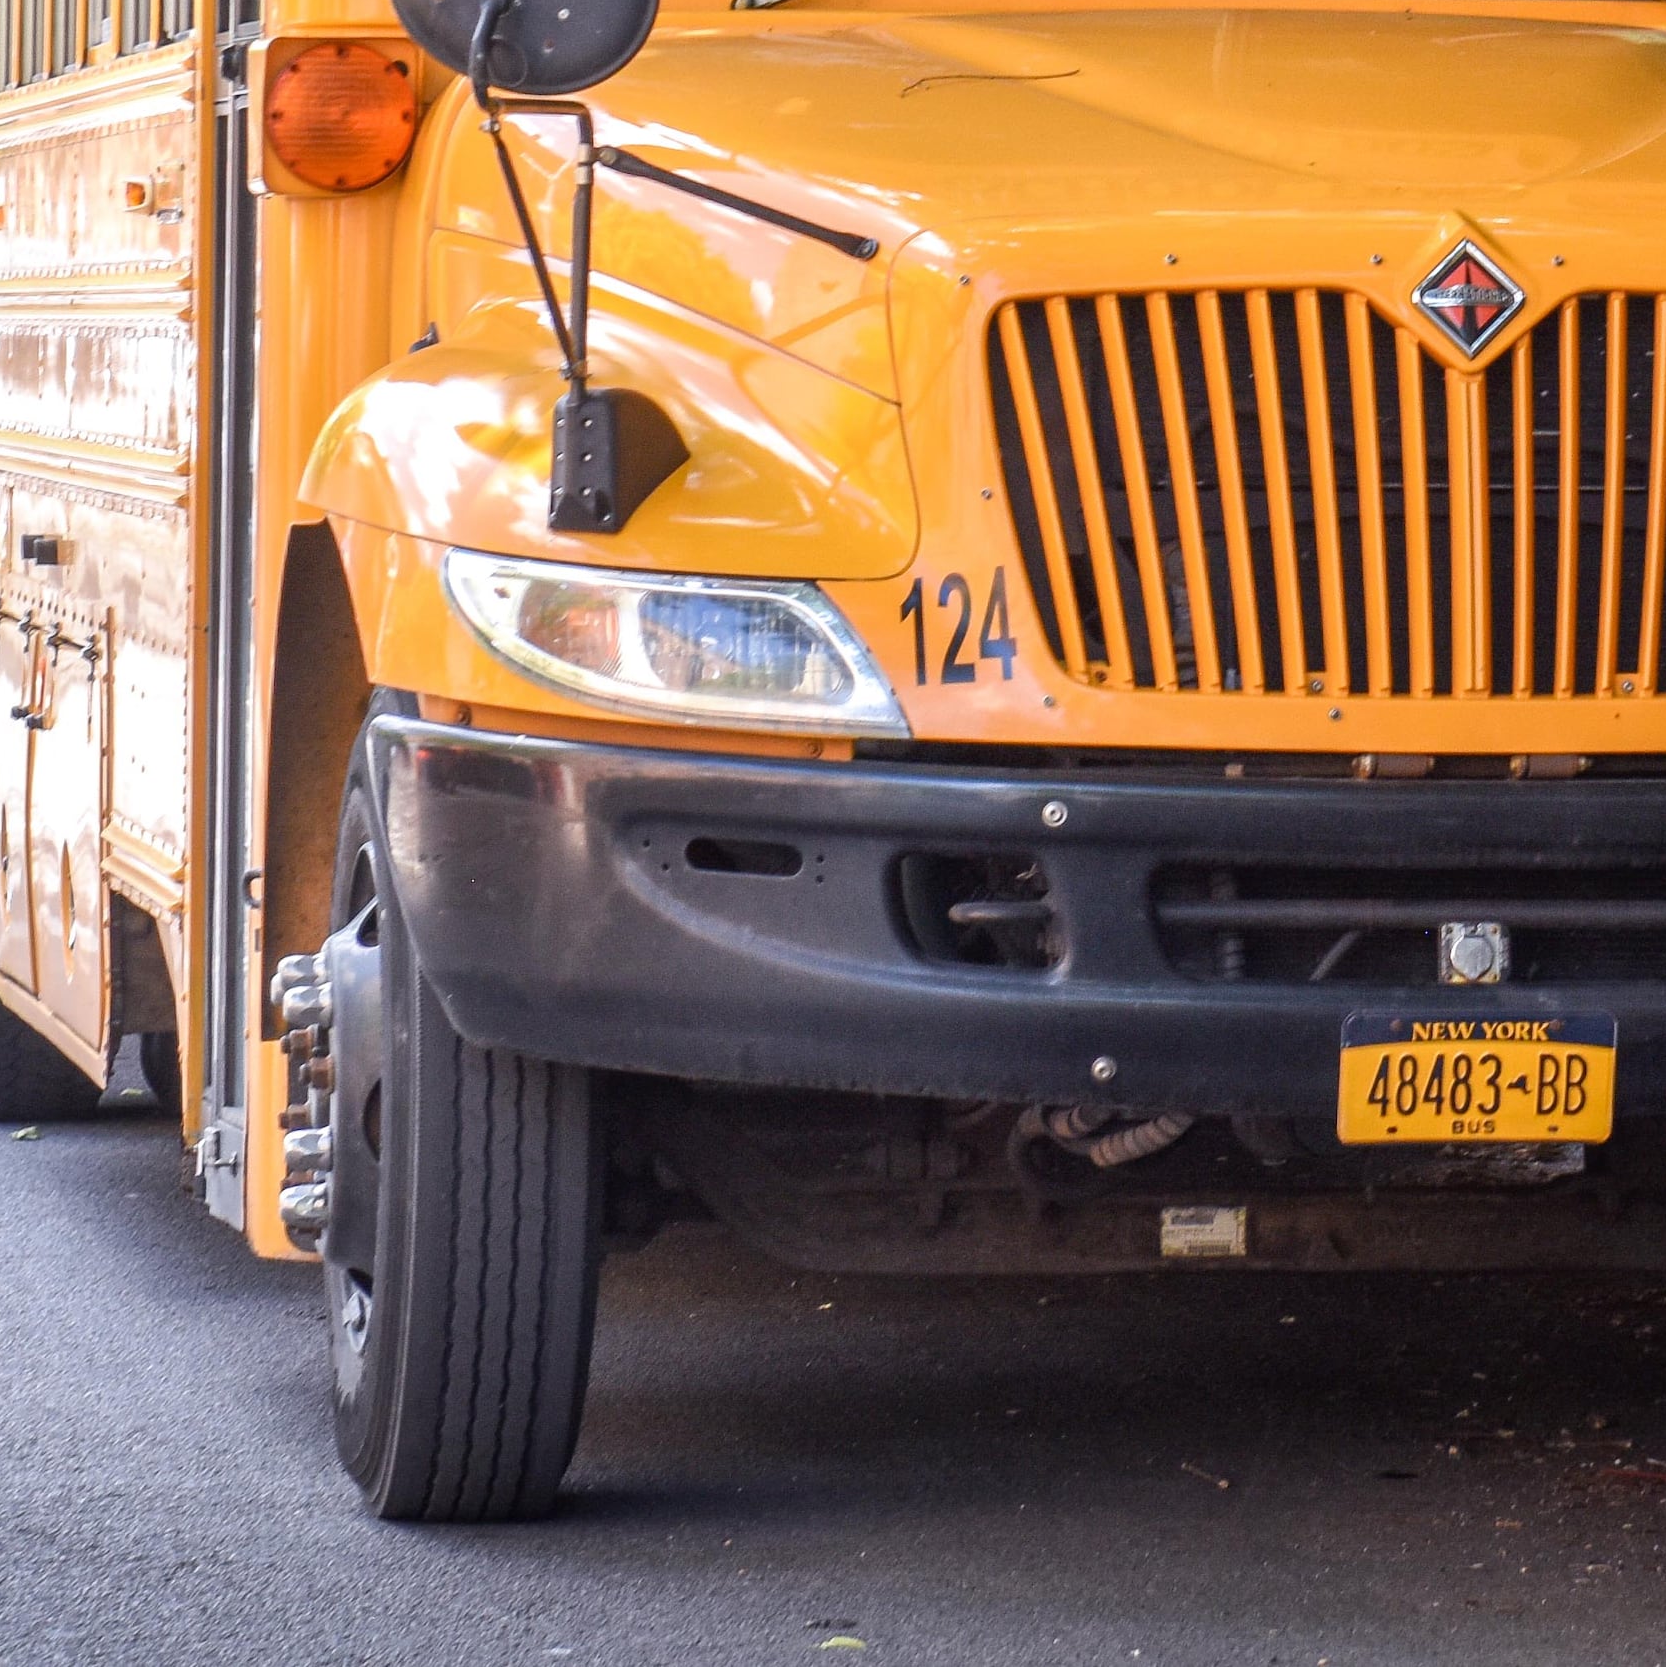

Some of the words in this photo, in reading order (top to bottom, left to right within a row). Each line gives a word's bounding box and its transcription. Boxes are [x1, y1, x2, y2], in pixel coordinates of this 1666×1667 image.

[900, 565, 1017, 686] 124
[1412, 1021, 1475, 1042] NEW
[1482, 1020, 1550, 1042] YORK
[1451, 1120, 1496, 1135] BUS
